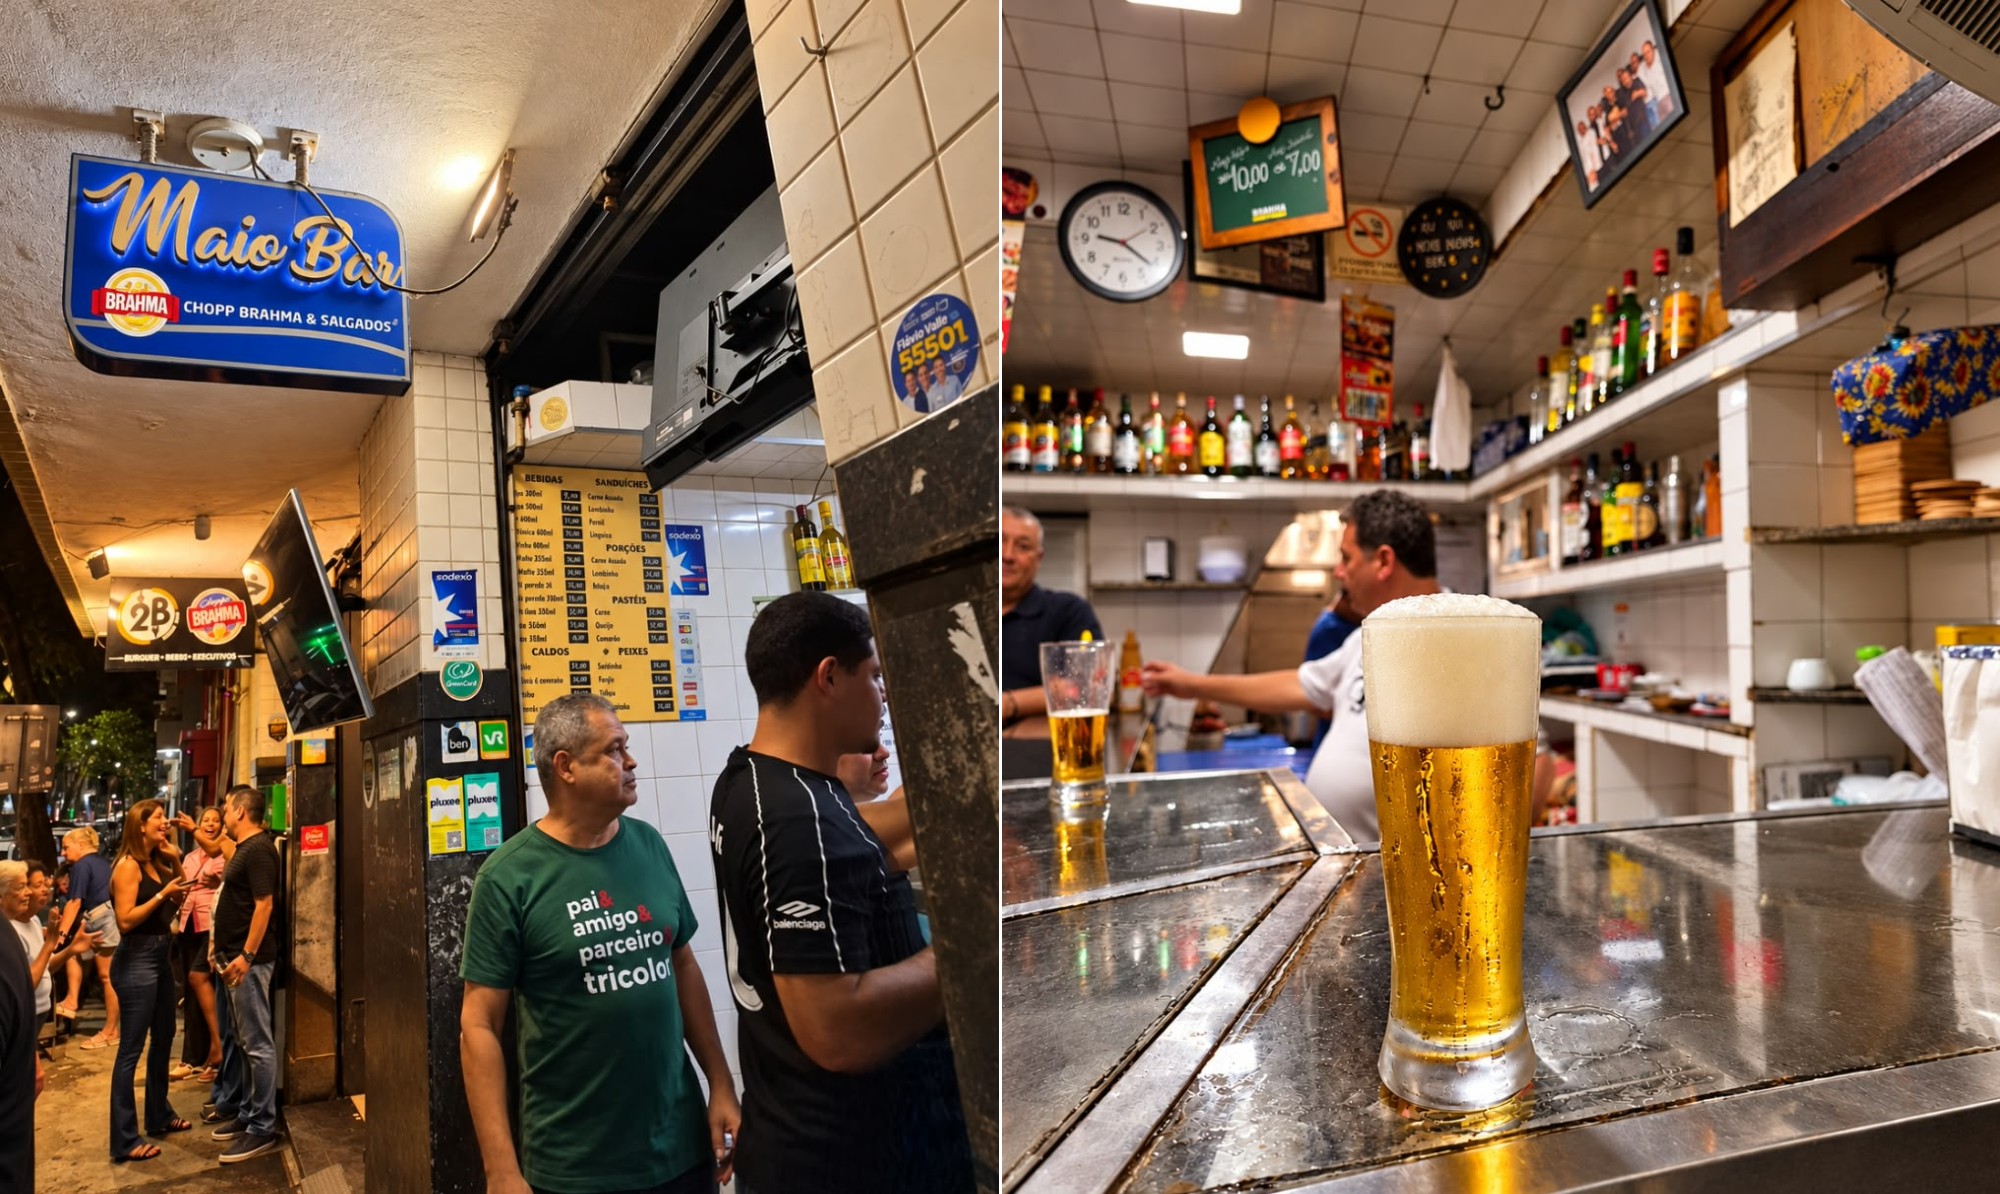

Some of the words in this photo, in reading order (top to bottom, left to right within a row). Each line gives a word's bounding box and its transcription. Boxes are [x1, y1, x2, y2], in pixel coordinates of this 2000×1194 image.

[1101, 205, 1111, 217] 11
[1118, 203, 1130, 215] 12
[1139, 209, 1144, 220] 1
[1087, 216, 1100, 229] 10
[1150, 222, 1158, 234] 2
[83, 172, 287, 267] Maio
[290, 215, 403, 288] Bar
[1081, 232, 1089, 244] 9
[1087, 251, 1096, 263] 8
[1102, 264, 1110, 276] 7
[1119, 272, 1127, 283] 6
[105, 291, 168, 314] BRAHMA
[183, 300, 235, 316] CHOPP
[239, 306, 302, 323] BRAHMA
[306, 313, 317, 324] &
[320, 314, 391, 332] SALGADOS
[924, 315, 948, 334] Valle
[899, 319, 968, 373] 55501
[525, 474, 563, 484] BEBIDAS
[595, 478, 649, 488] SANDUÍCHES
[669, 529, 701, 540] sodexo
[606, 543, 646, 554] PORÇÕES
[436, 572, 472, 581] sodexo
[612, 595, 647, 604] PASTÉIS
[130, 597, 170, 631] 2B
[193, 605, 242, 627] BRAHMA
[532, 648, 569, 656] CALDOS
[449, 739, 468, 749] ben
[484, 731, 504, 745] VR
[430, 797, 460, 809] pluxee
[468, 795, 498, 807] pluxee
[566, 890, 614, 920] pai&
[572, 904, 653, 937] amigo&
[773, 918, 826, 931] balenciaga
[584, 957, 671, 994] tricolor
